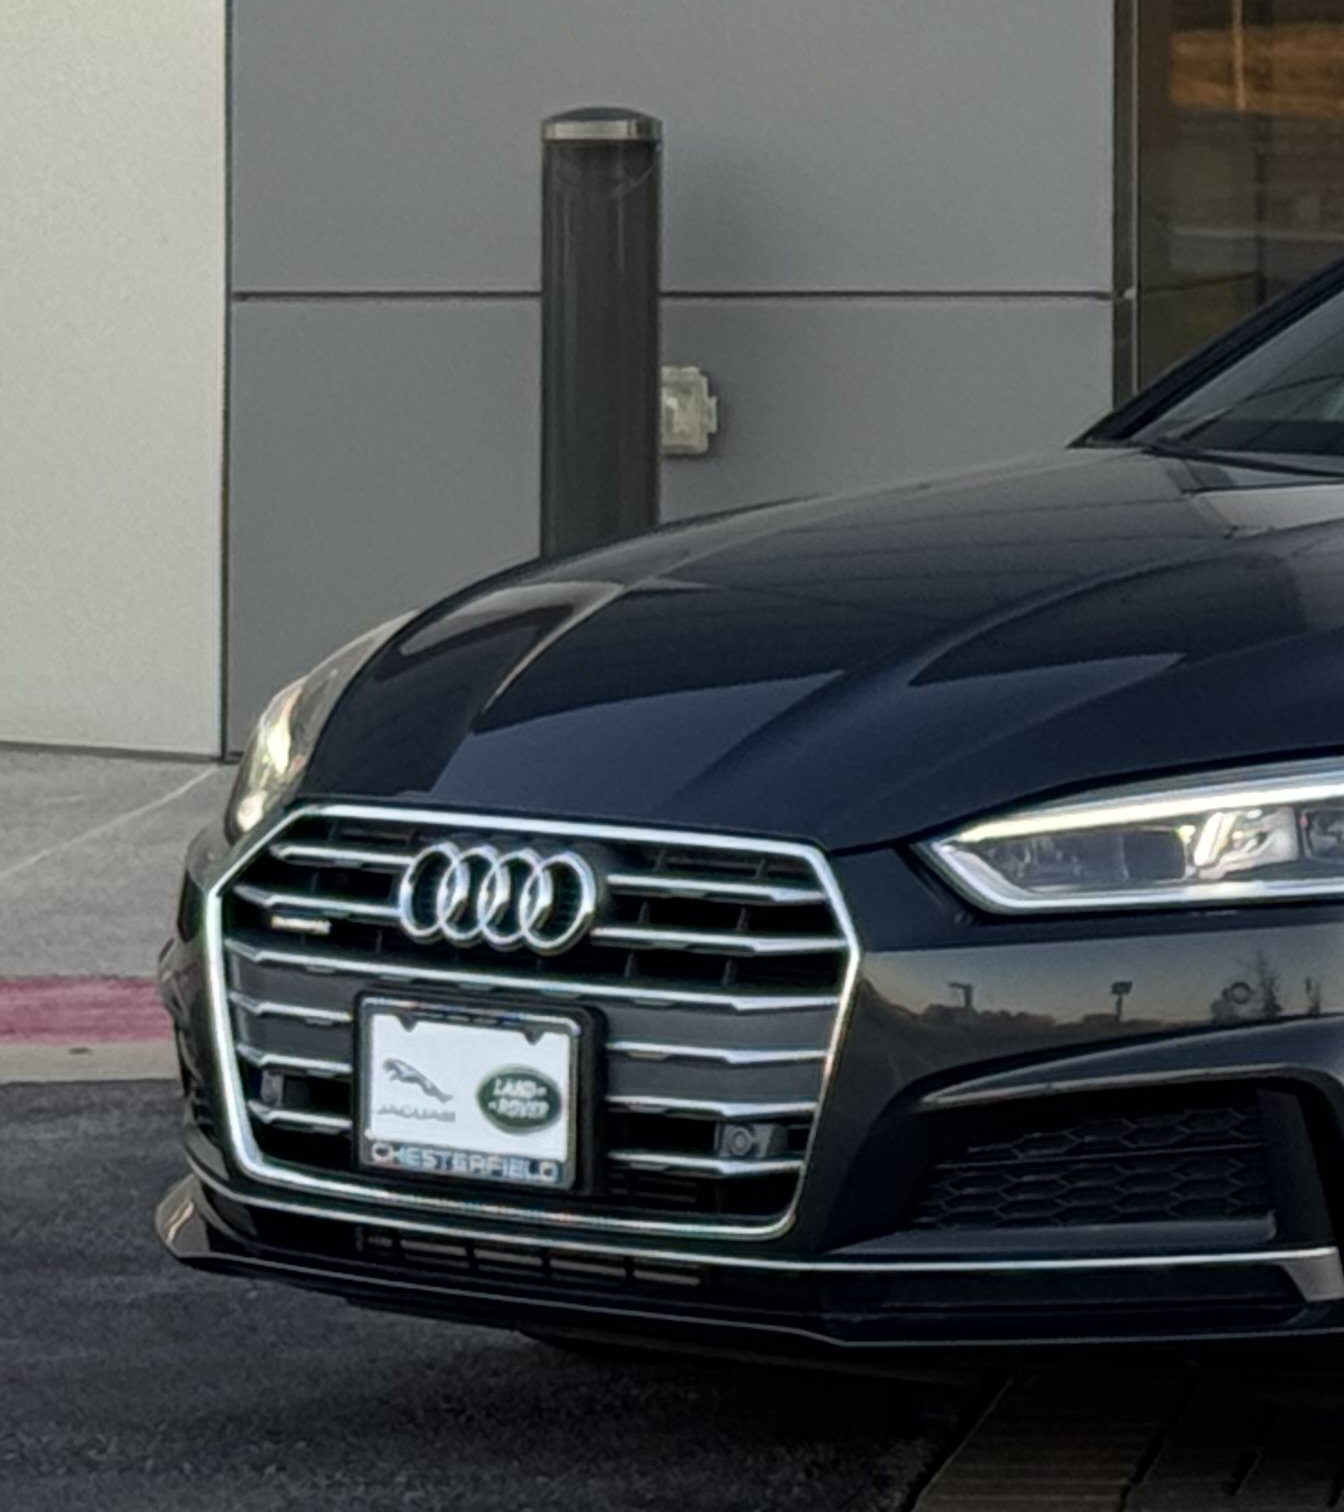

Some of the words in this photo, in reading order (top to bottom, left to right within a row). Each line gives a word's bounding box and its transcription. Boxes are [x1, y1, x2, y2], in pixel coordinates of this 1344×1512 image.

[494, 1078, 538, 1096] LAND
[377, 1105, 456, 1123] JAGUAR
[497, 1100, 550, 1119] ROVER
[371, 1142, 558, 1182] CHESTERFIELD
